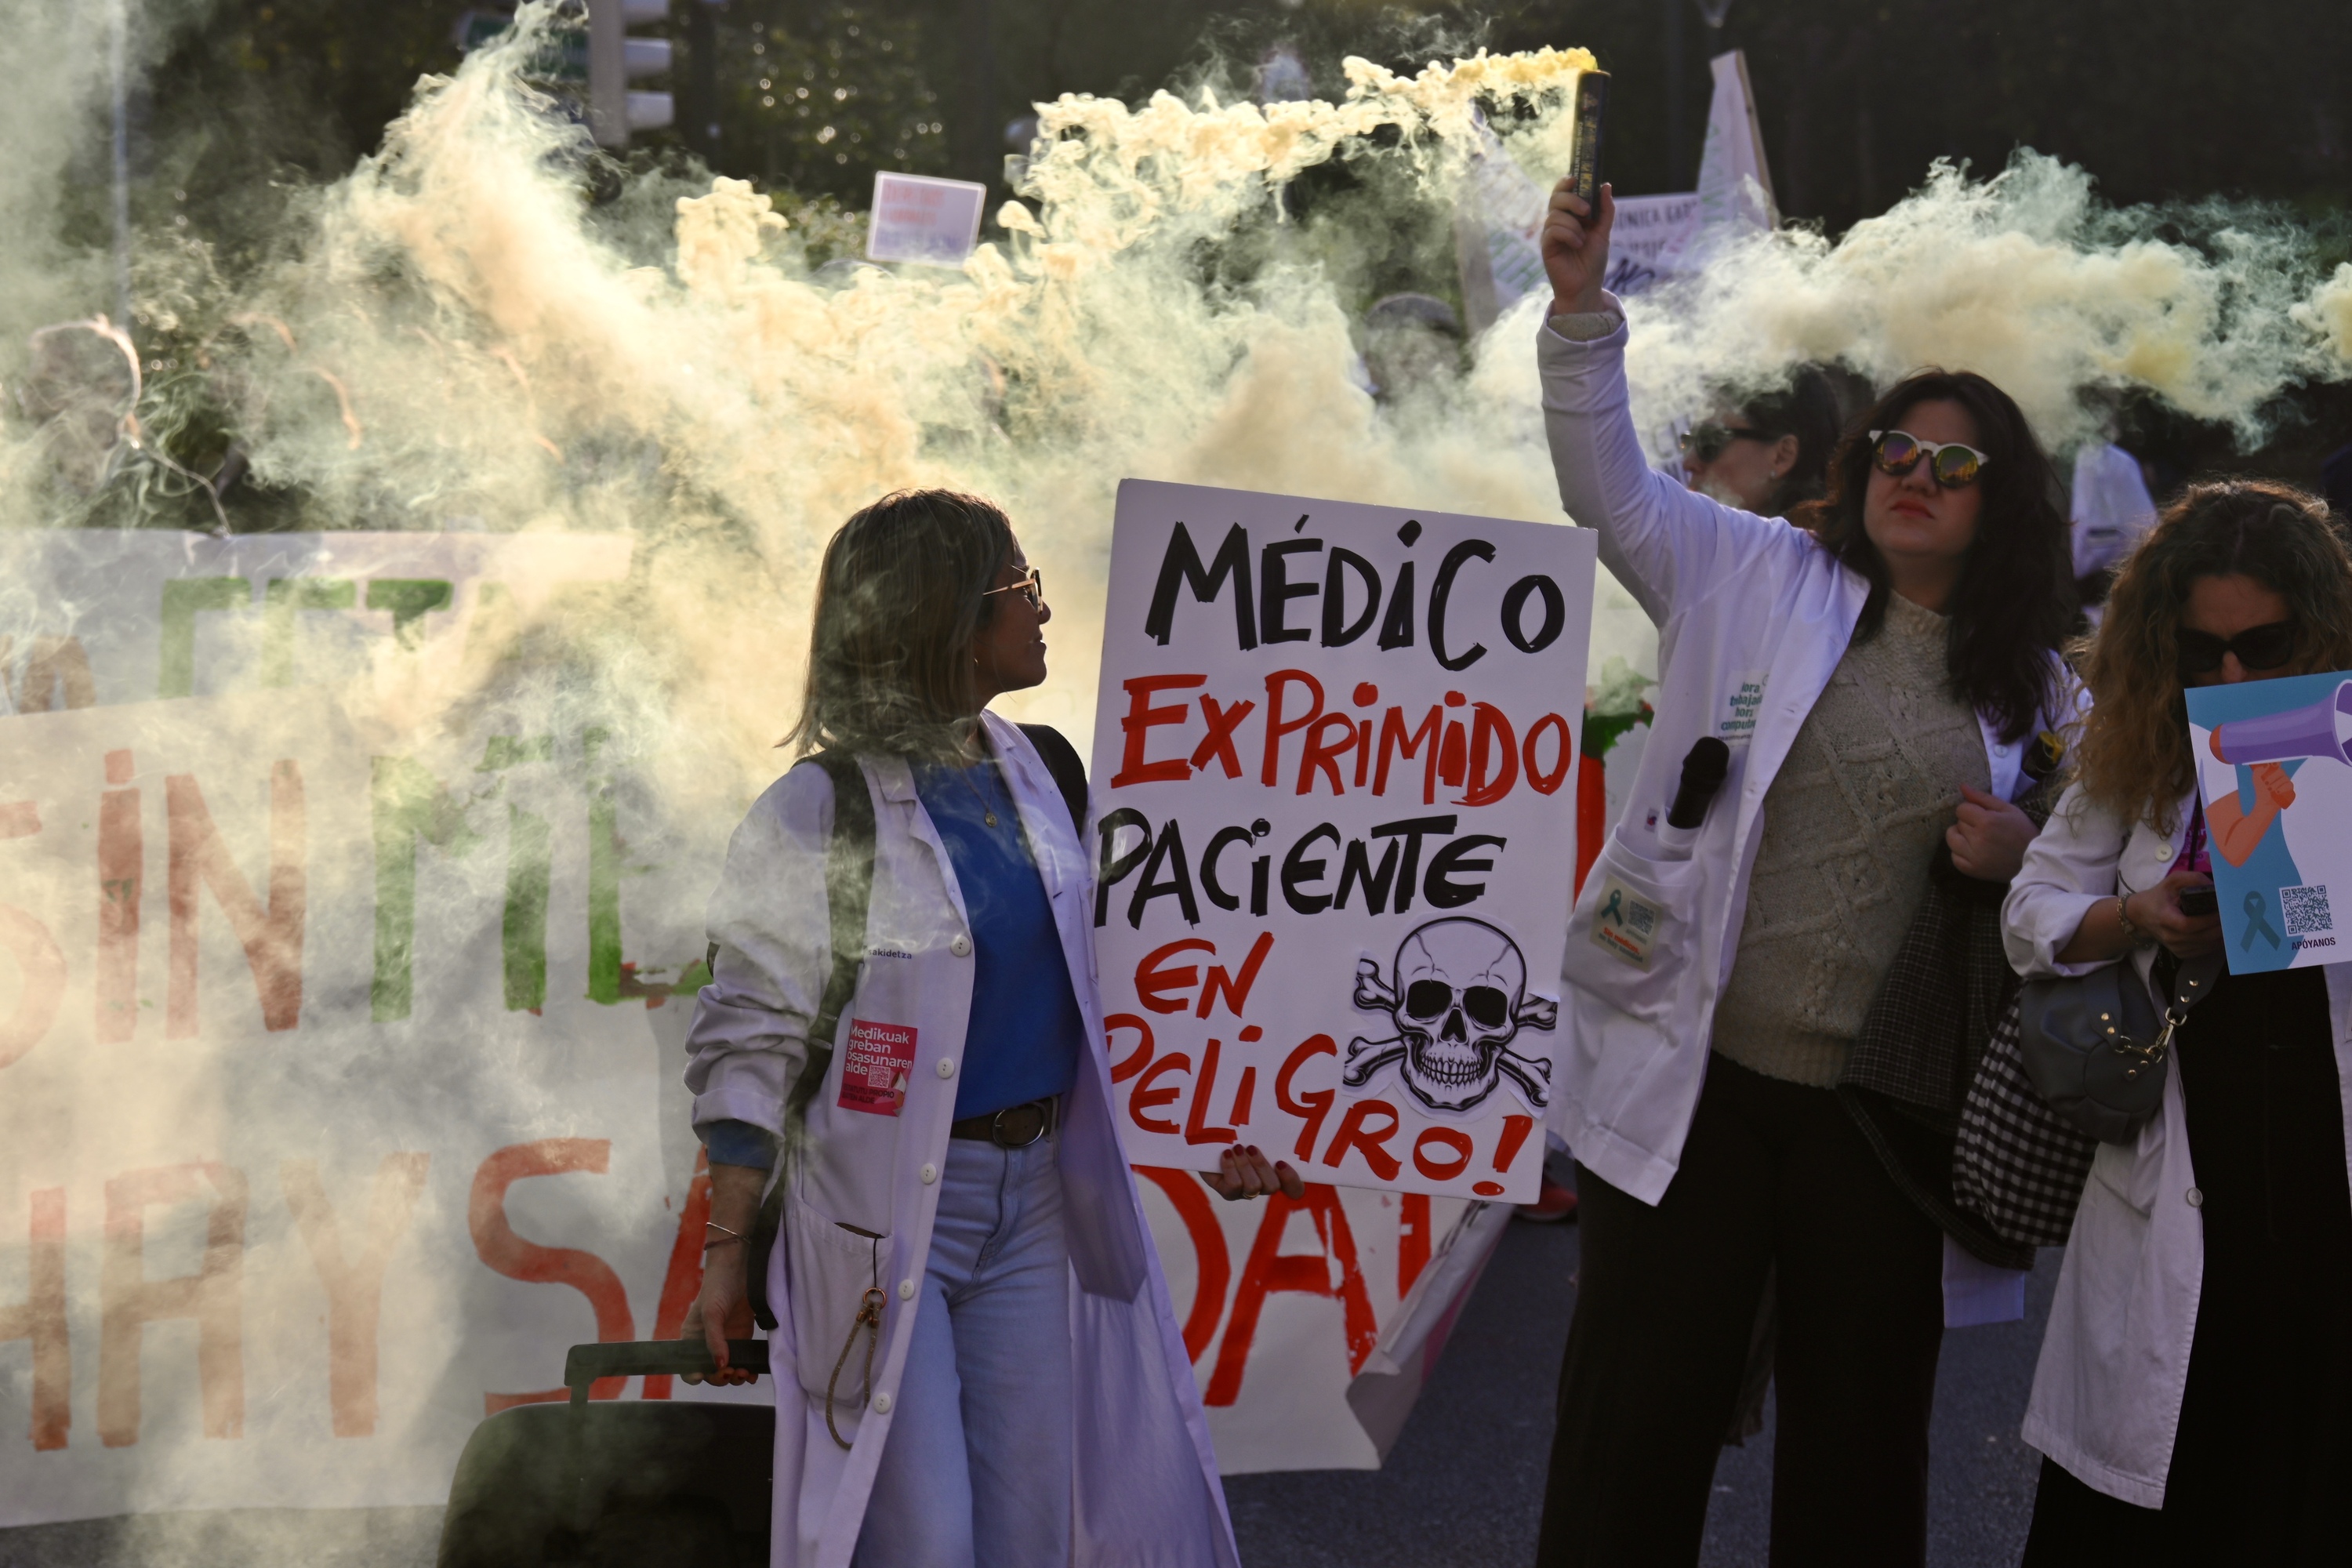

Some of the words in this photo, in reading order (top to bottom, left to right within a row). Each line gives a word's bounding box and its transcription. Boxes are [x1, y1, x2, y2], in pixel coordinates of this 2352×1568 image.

[2291, 937, 2336, 951] APÓYANOS
[867, 948, 913, 960] sakidetza
[1134, 931, 1274, 1019] EN
[851, 1025, 909, 1044] Medikuak
[848, 1039, 891, 1054] greban
[847, 1051, 913, 1069] osasunaren
[845, 1062, 868, 1076] alde
[869, 1089, 895, 1098] PROPIO
